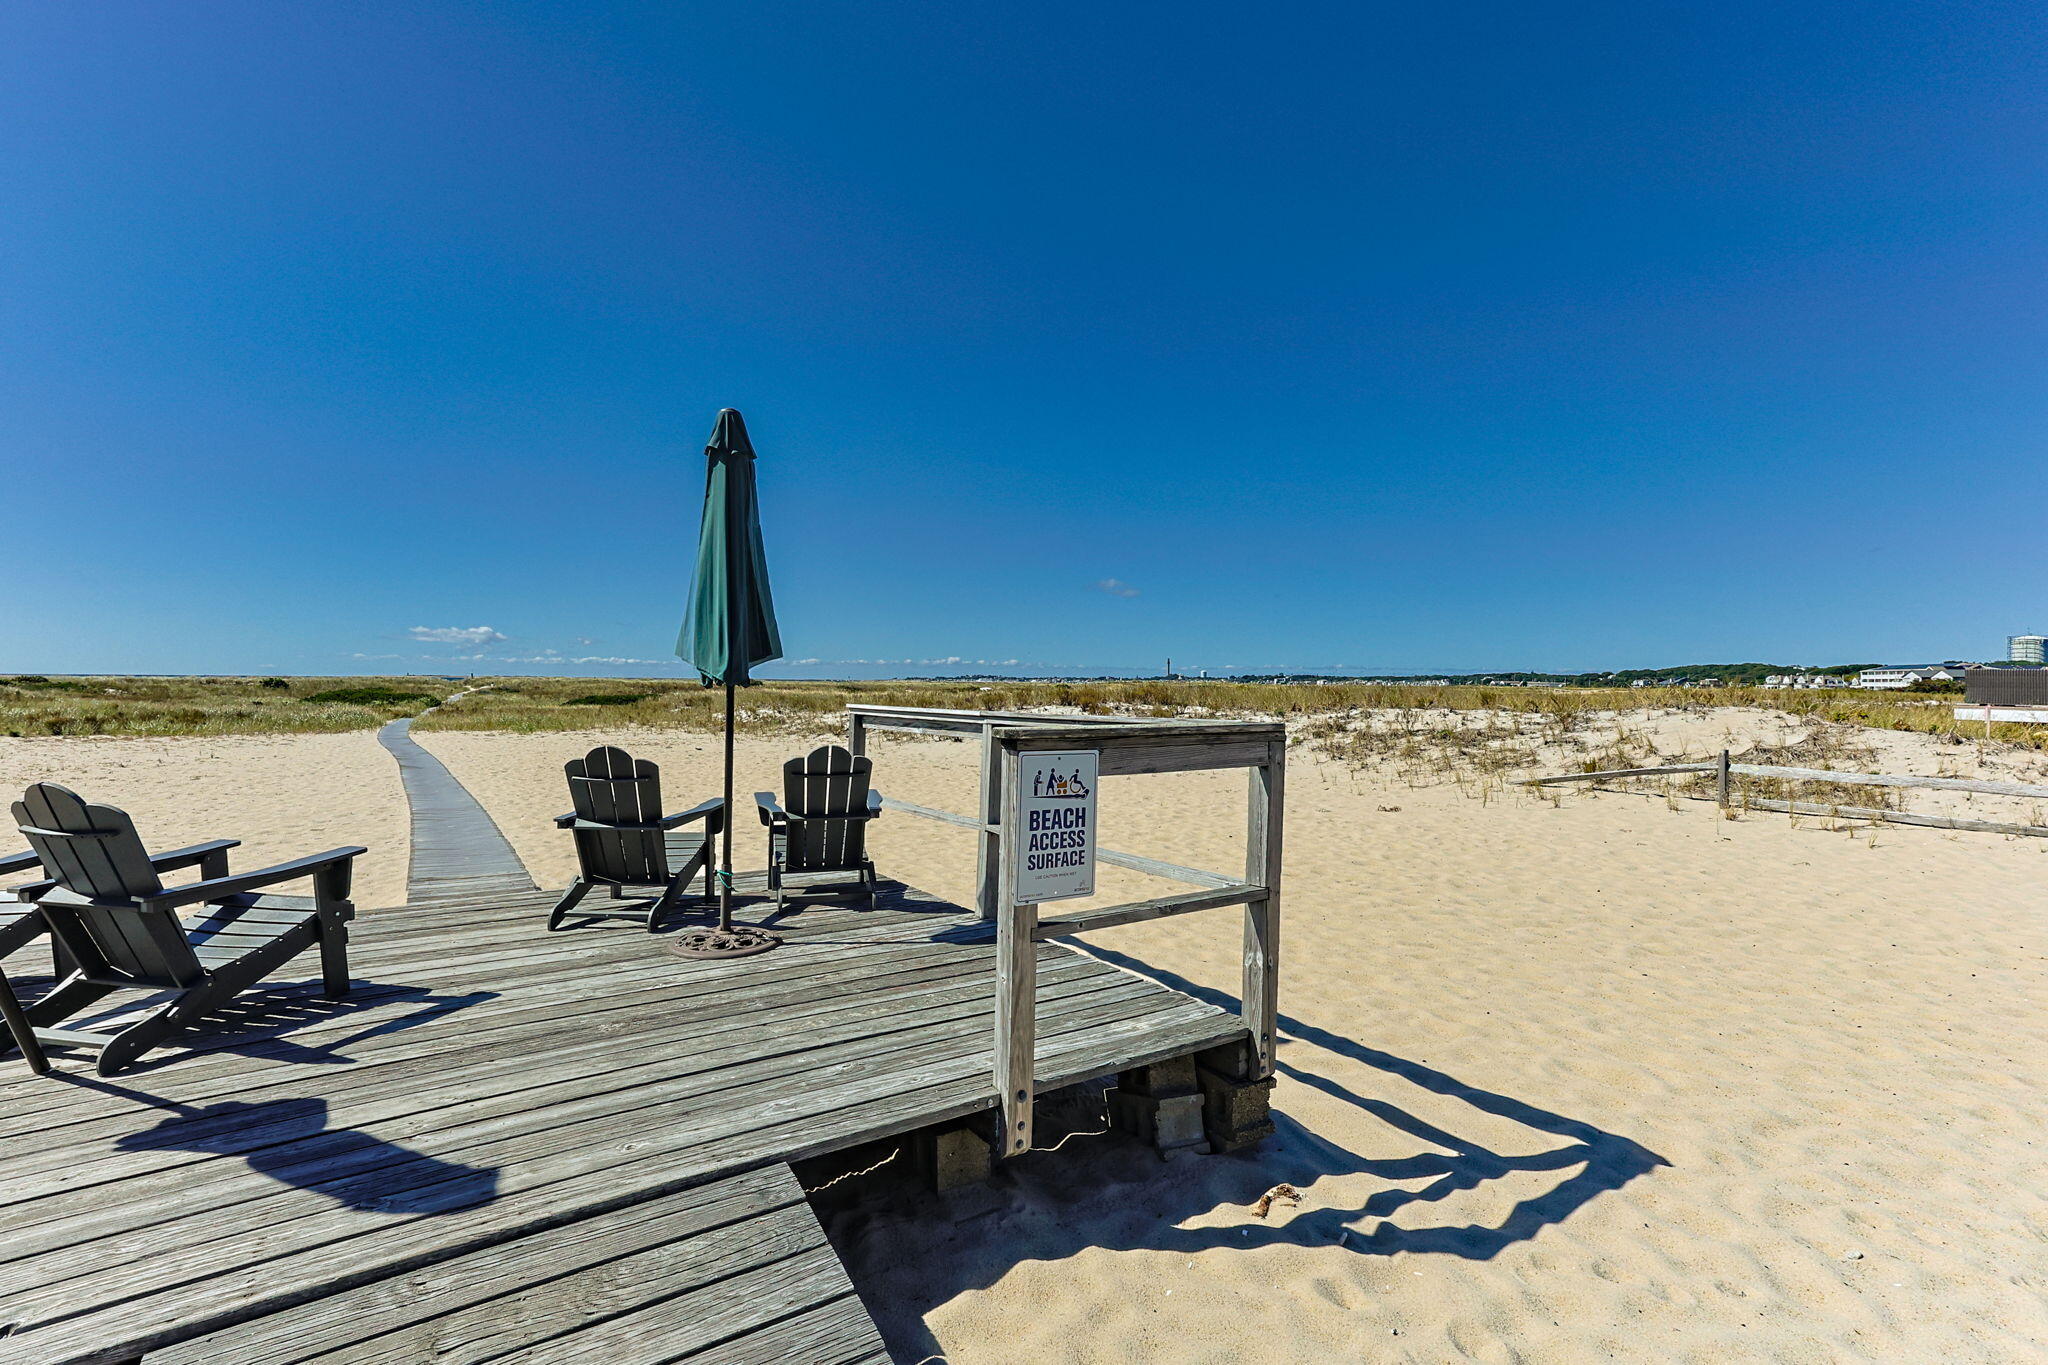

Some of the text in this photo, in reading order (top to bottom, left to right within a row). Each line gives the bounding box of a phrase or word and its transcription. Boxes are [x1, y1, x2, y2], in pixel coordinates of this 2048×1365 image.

[1029, 806, 1086, 831] BEACH
[1028, 829, 1086, 852] ACCESS
[1027, 849, 1086, 871] SURFACE
